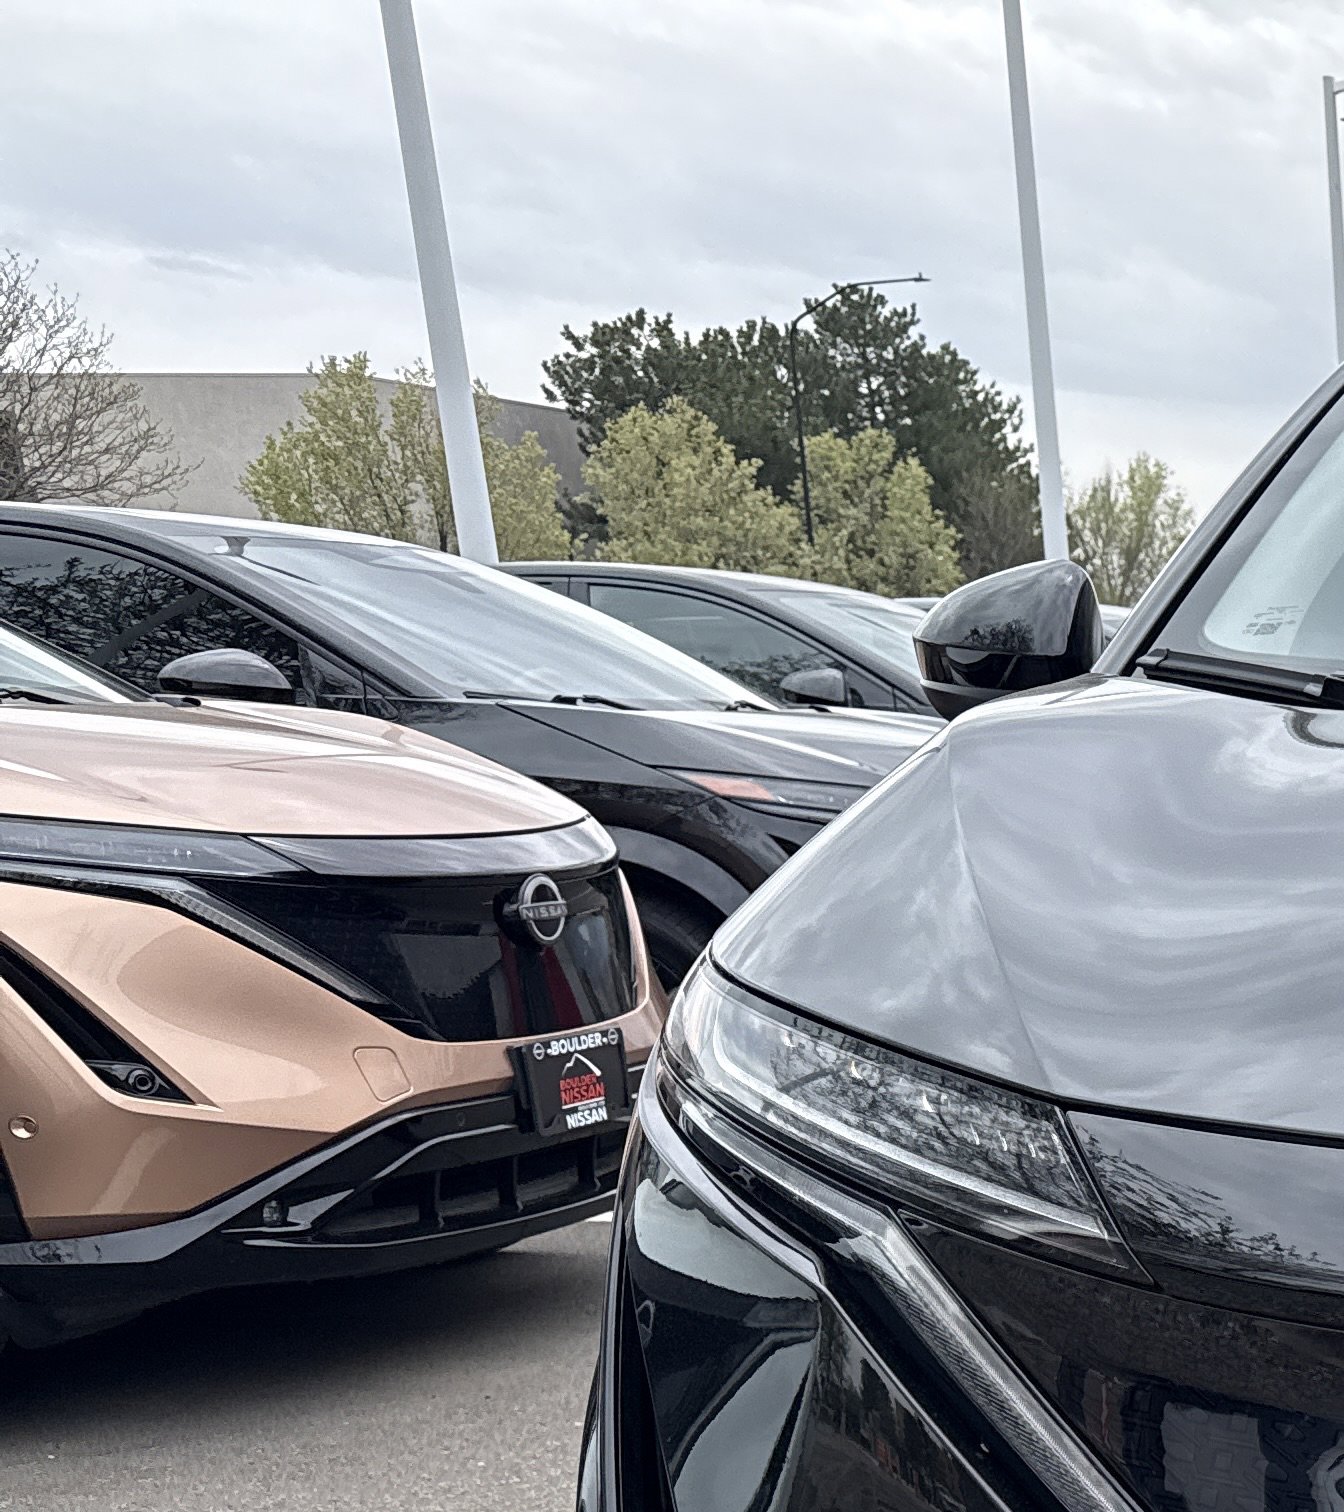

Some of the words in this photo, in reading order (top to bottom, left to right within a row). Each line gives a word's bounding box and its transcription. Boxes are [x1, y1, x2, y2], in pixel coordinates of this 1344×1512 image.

[550, 1032, 602, 1056] BOULDER
[560, 1074, 597, 1090] BOULDER
[561, 1082, 605, 1105] NISSAN
[566, 1106, 608, 1130] NISSAN
